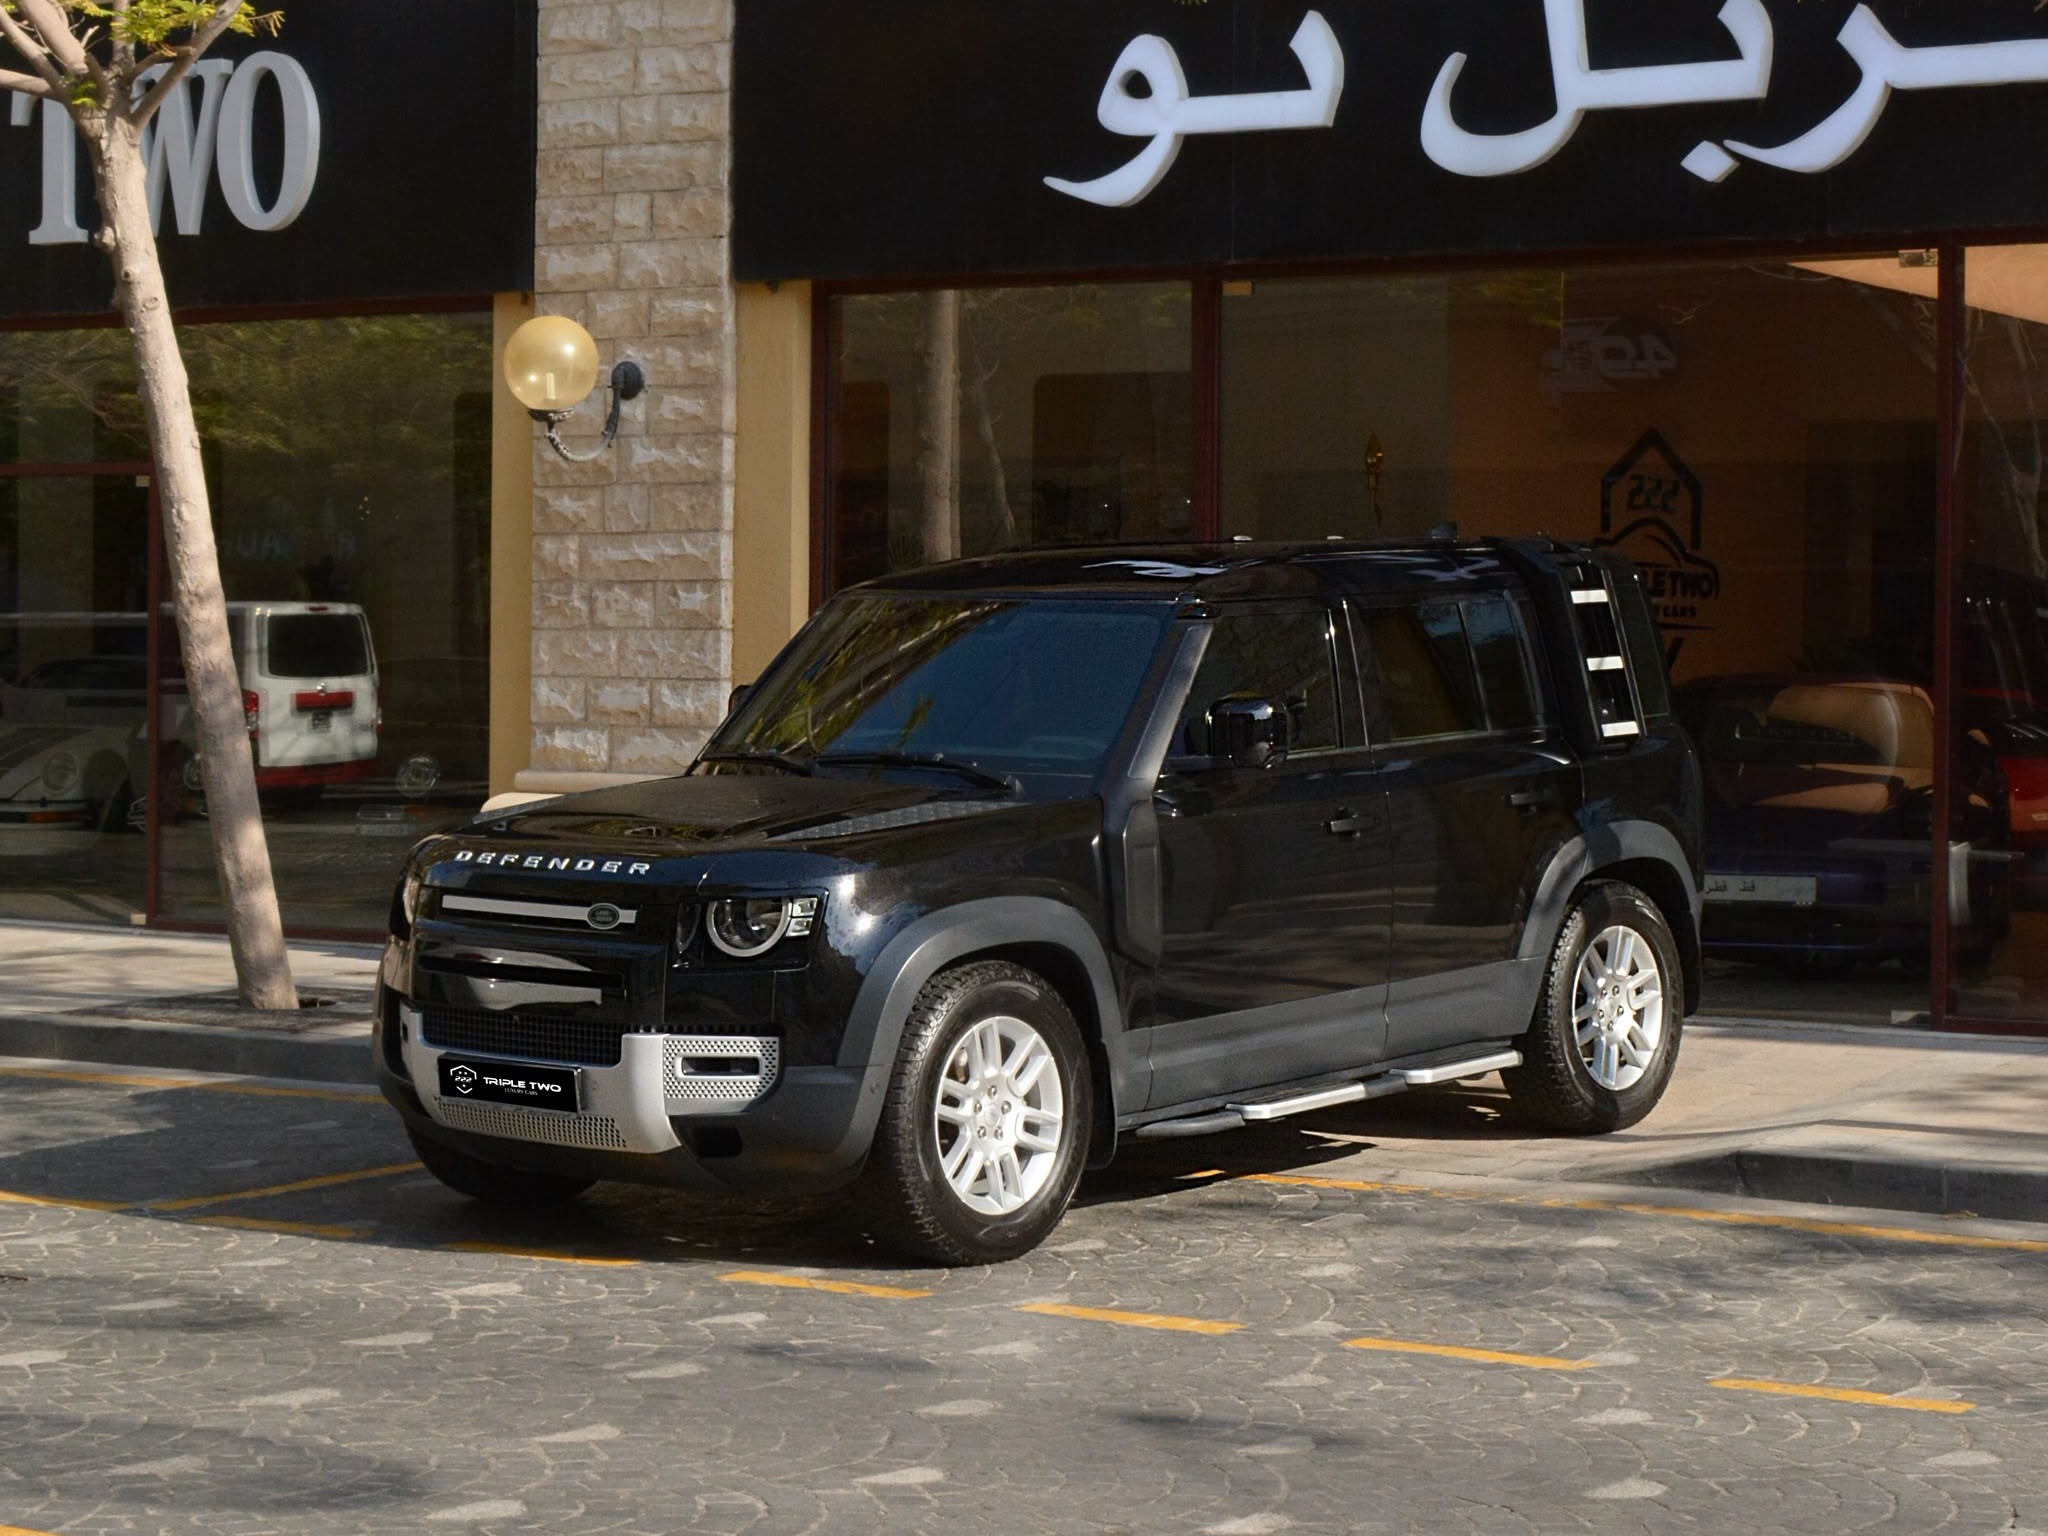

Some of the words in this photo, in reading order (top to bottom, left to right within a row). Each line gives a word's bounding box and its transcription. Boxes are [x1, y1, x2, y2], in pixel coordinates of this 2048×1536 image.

[11, 50, 320, 245] TWO
[1668, 571, 1713, 599] TWO
[454, 850, 650, 875] DEFENDER
[455, 1075, 472, 1083] 222
[483, 1076, 526, 1089] TRIPLE
[529, 1081, 562, 1093] TWO
